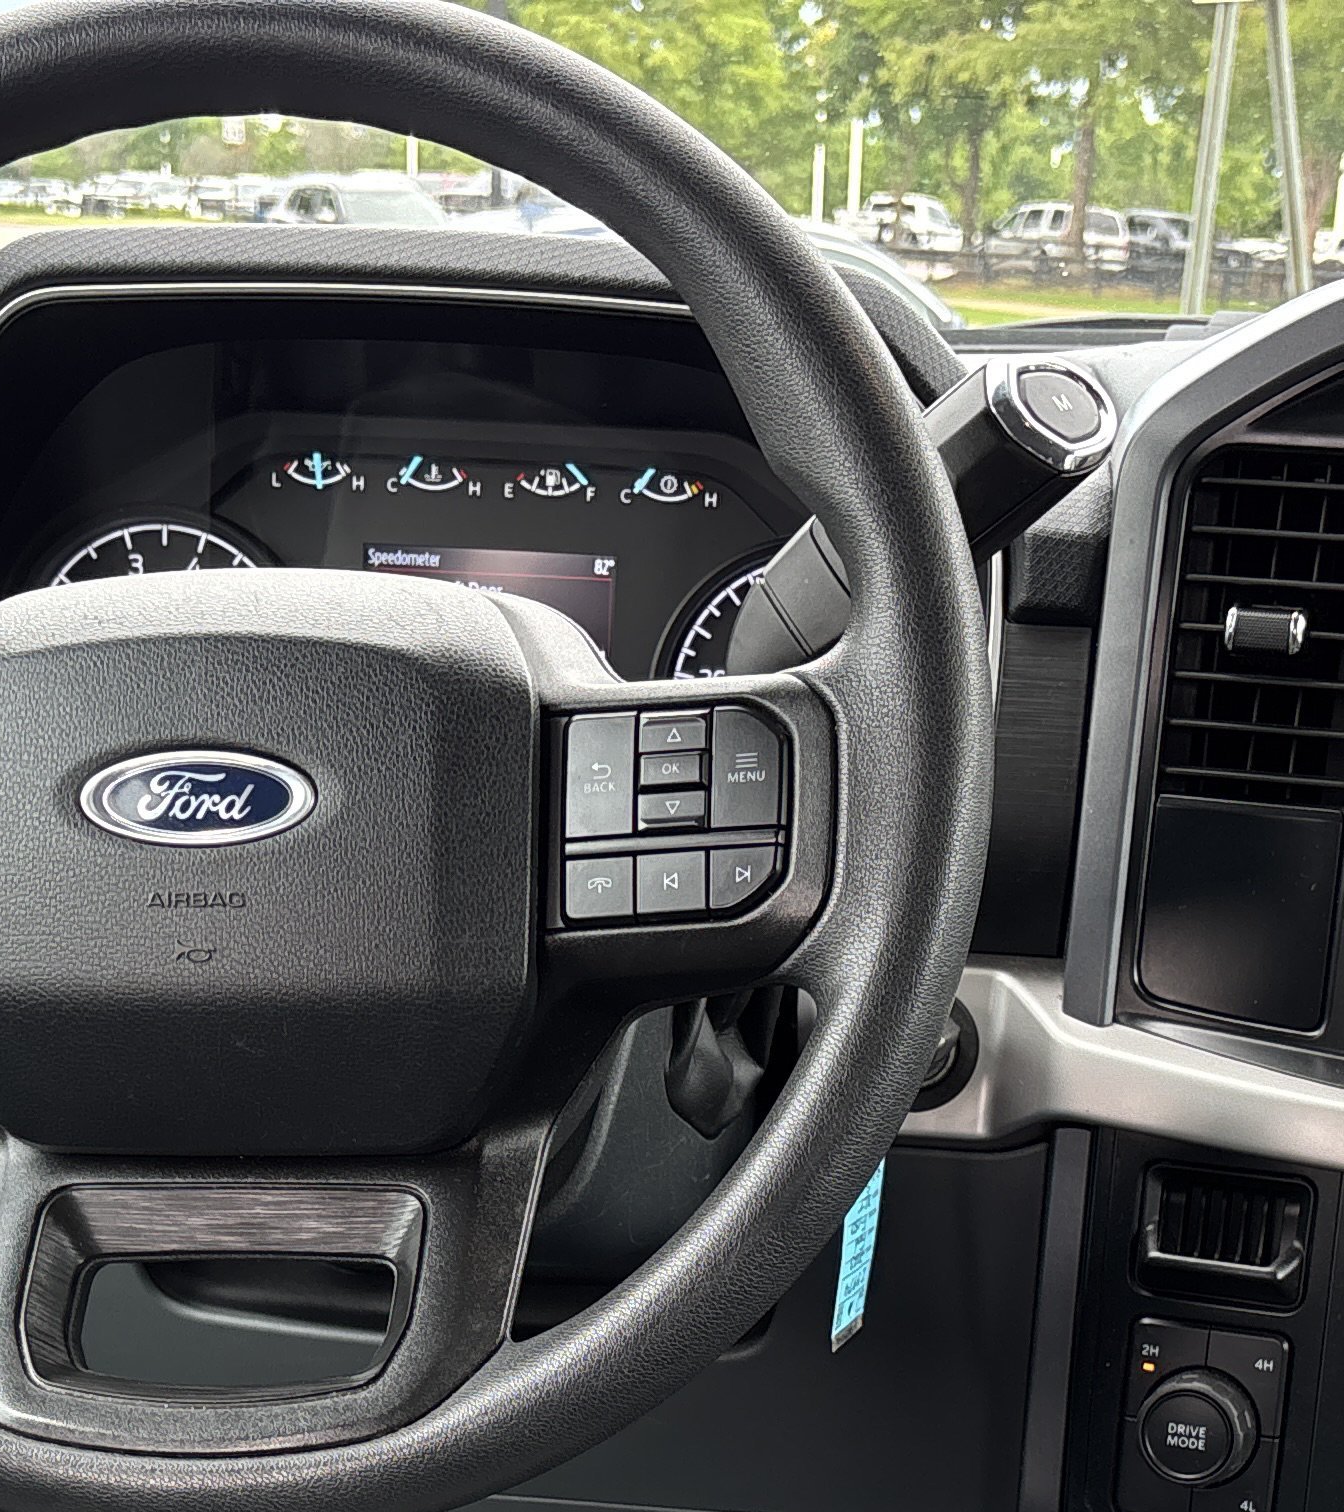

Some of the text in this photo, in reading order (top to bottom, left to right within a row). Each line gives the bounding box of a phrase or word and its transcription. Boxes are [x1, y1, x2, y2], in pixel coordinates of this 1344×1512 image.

[1050, 393, 1073, 412] M
[271, 471, 282, 488] L
[351, 475, 365, 492] H
[386, 477, 399, 493] C
[468, 481, 482, 497] H
[503, 482, 514, 499] E
[585, 486, 596, 502] F
[619, 488, 632, 504] C
[704, 492, 718, 508] H
[128, 553, 144, 576] 3
[367, 548, 441, 568] Speedometer
[661, 763, 680, 775] OK
[727, 769, 766, 783] MENU
[137, 770, 255, 821] Ford
[583, 782, 616, 794] BACK
[147, 890, 247, 909] AIRBAG
[1141, 1343, 1160, 1358] 2H
[1254, 1358, 1274, 1372] 4H
[1167, 1422, 1207, 1438] DRIVE
[1166, 1435, 1206, 1451] MODE
